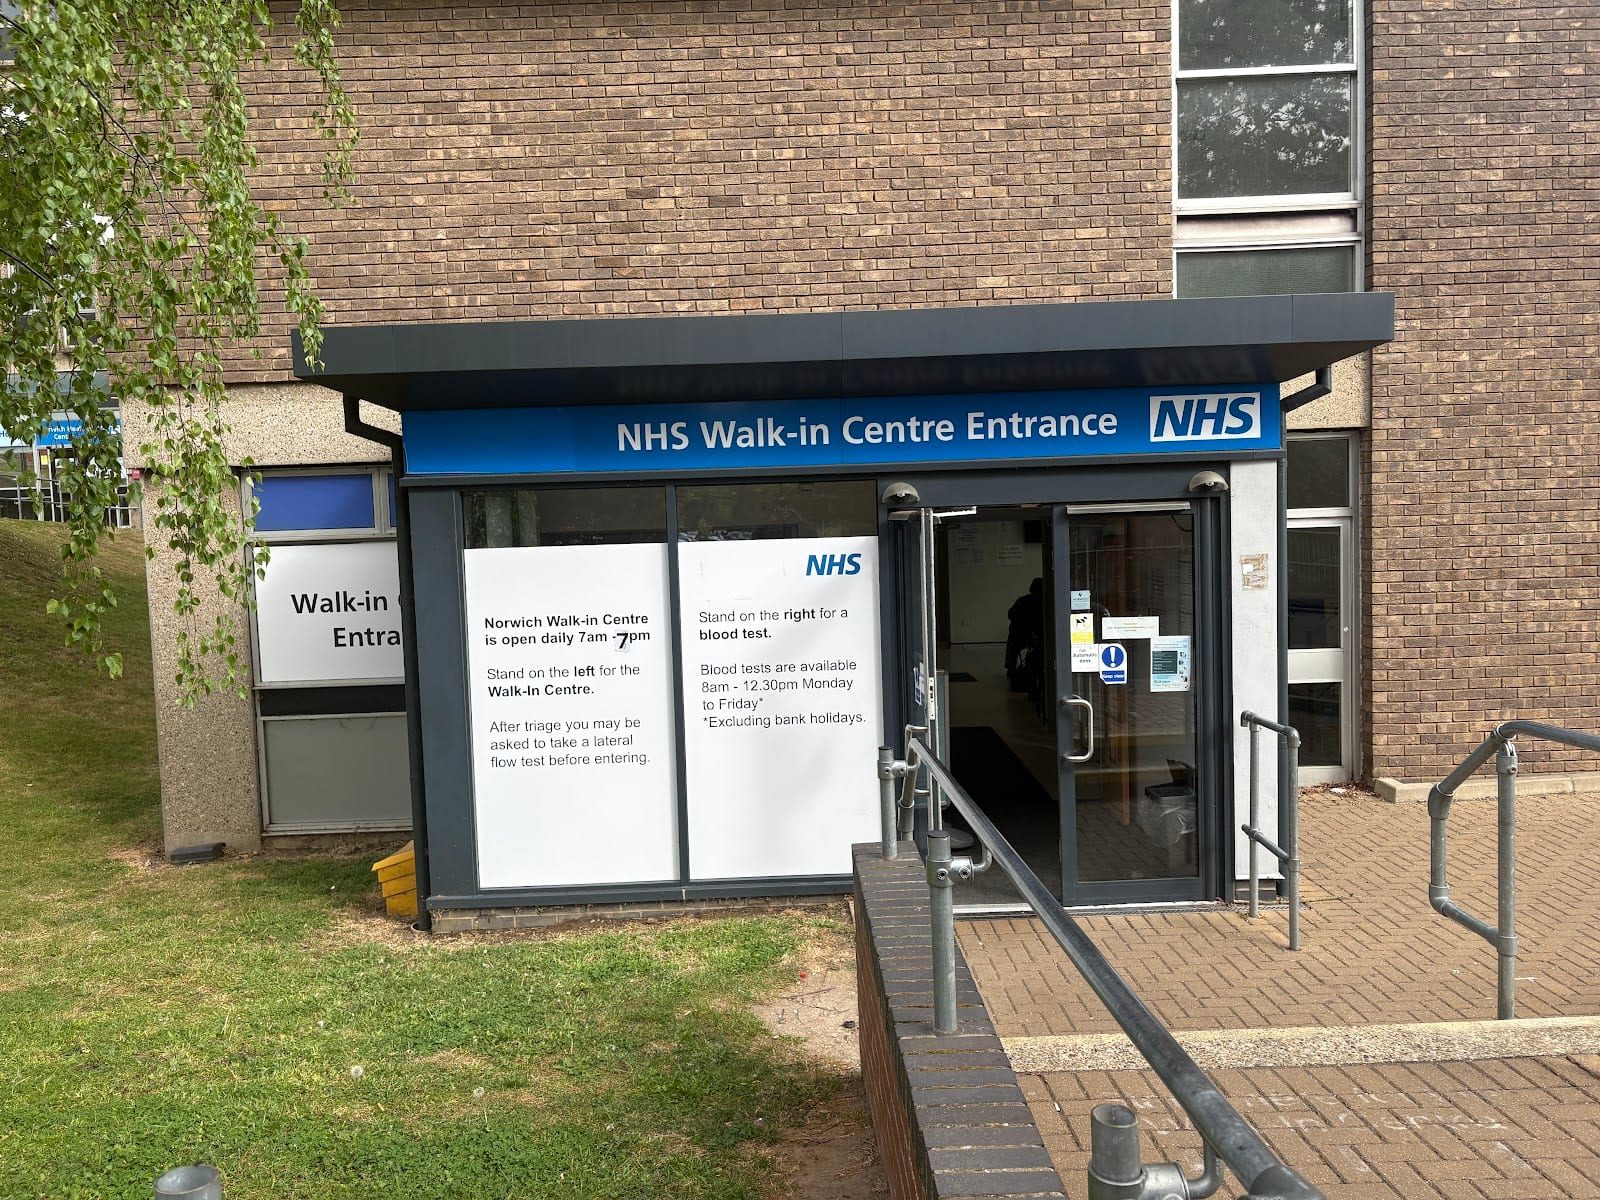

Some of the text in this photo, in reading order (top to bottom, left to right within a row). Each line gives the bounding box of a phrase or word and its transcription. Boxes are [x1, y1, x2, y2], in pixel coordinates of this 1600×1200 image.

[1151, 392, 1258, 440] NHS
[618, 412, 1117, 451] NHS Walk-in Centre Entrance
[806, 553, 862, 576] NHS
[291, 590, 388, 614] Walk-in
[485, 614, 648, 629] Norwich Walk-in Centre
[699, 607, 848, 623] Stand on the right for a
[485, 634, 497, 645] is
[502, 636, 536, 648] open
[541, 632, 574, 646] daily
[578, 631, 607, 643] 7am
[699, 628, 772, 640] blood test.
[487, 664, 640, 680] Stand on the left for the
[701, 659, 857, 675] Blood tests are available
[488, 684, 594, 697] Walk-In Centre.
[702, 681, 729, 693] 8am
[743, 679, 798, 693] 12.30pm
[803, 677, 853, 691] Monday
[703, 700, 714, 710] to
[489, 717, 641, 734] After triage you may be
[775, 713, 806, 725] bank
[810, 712, 866, 726] holidays.
[490, 734, 633, 750] asked to take a lateral
[491, 752, 650, 768] flow test before entering.
